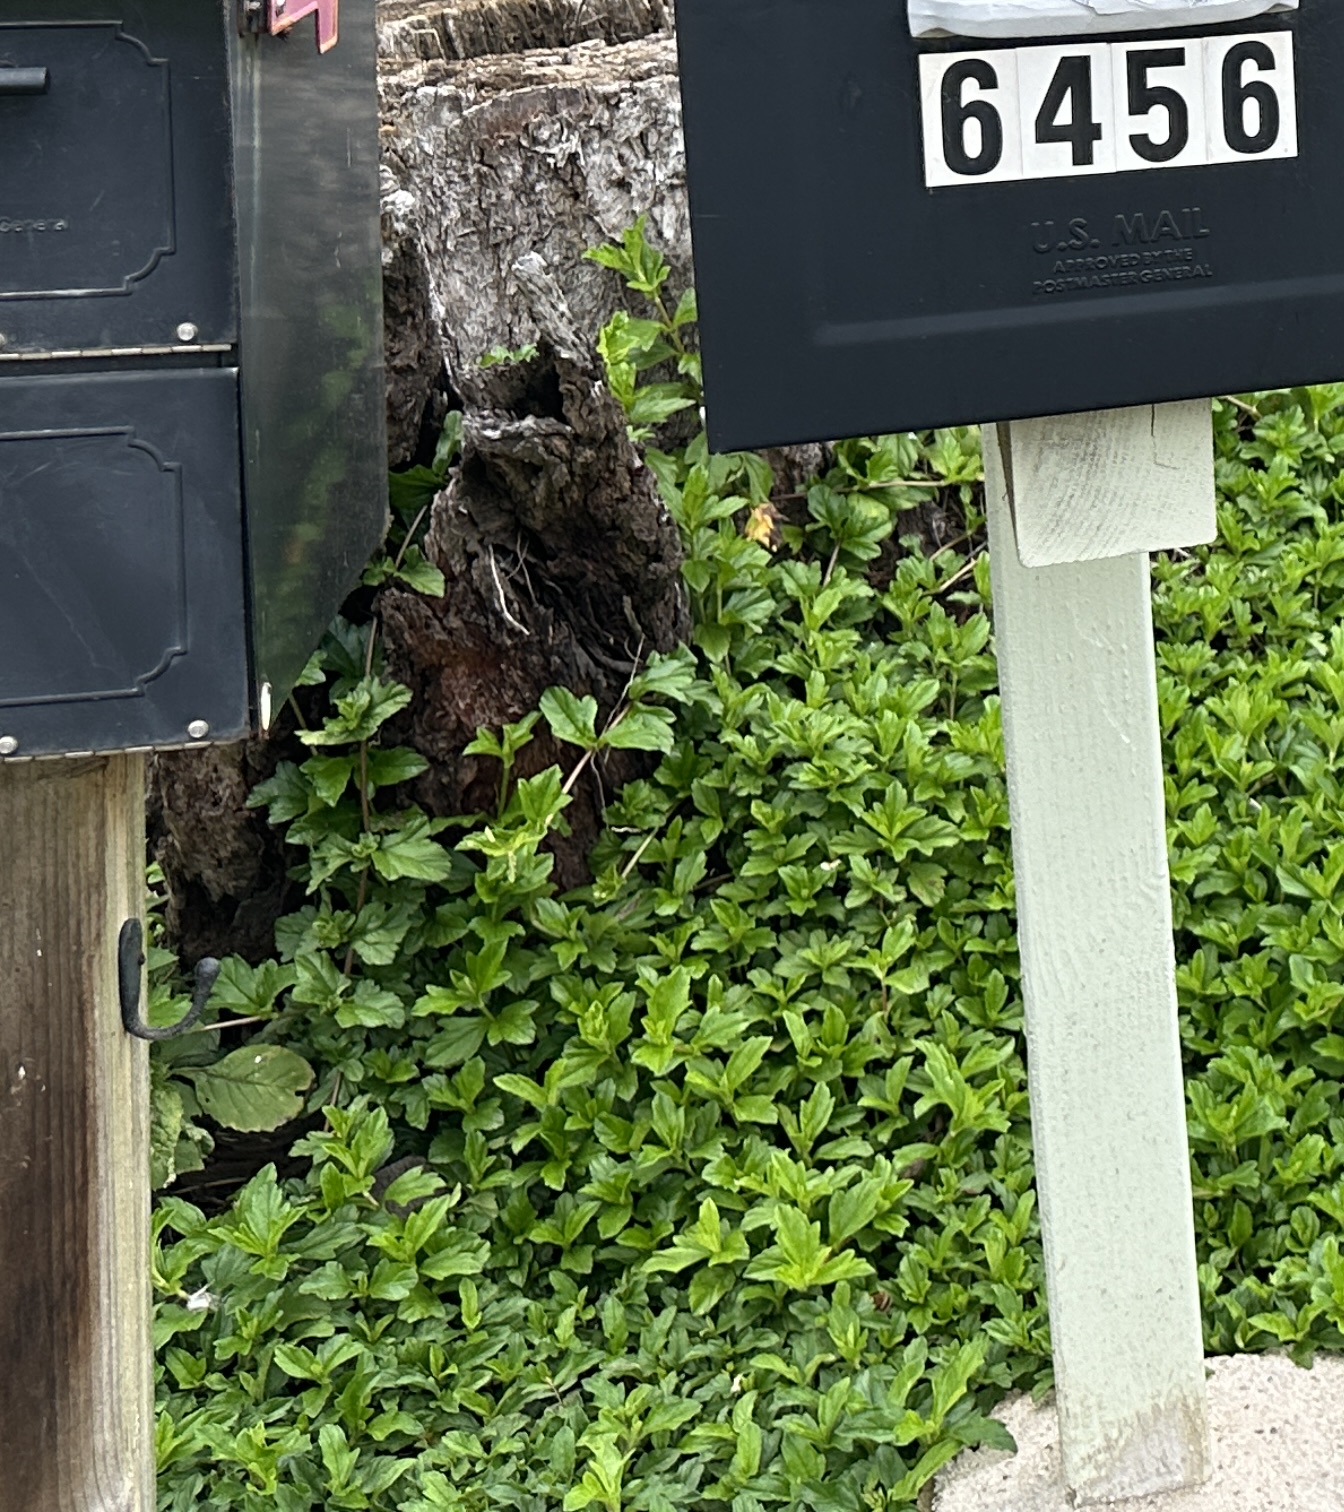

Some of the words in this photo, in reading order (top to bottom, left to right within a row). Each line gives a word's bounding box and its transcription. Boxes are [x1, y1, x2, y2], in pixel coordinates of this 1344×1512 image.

[940, 40, 1280, 176] 6456
[1030, 217, 1102, 255] U.S.
[1112, 207, 1211, 247] MAIL
